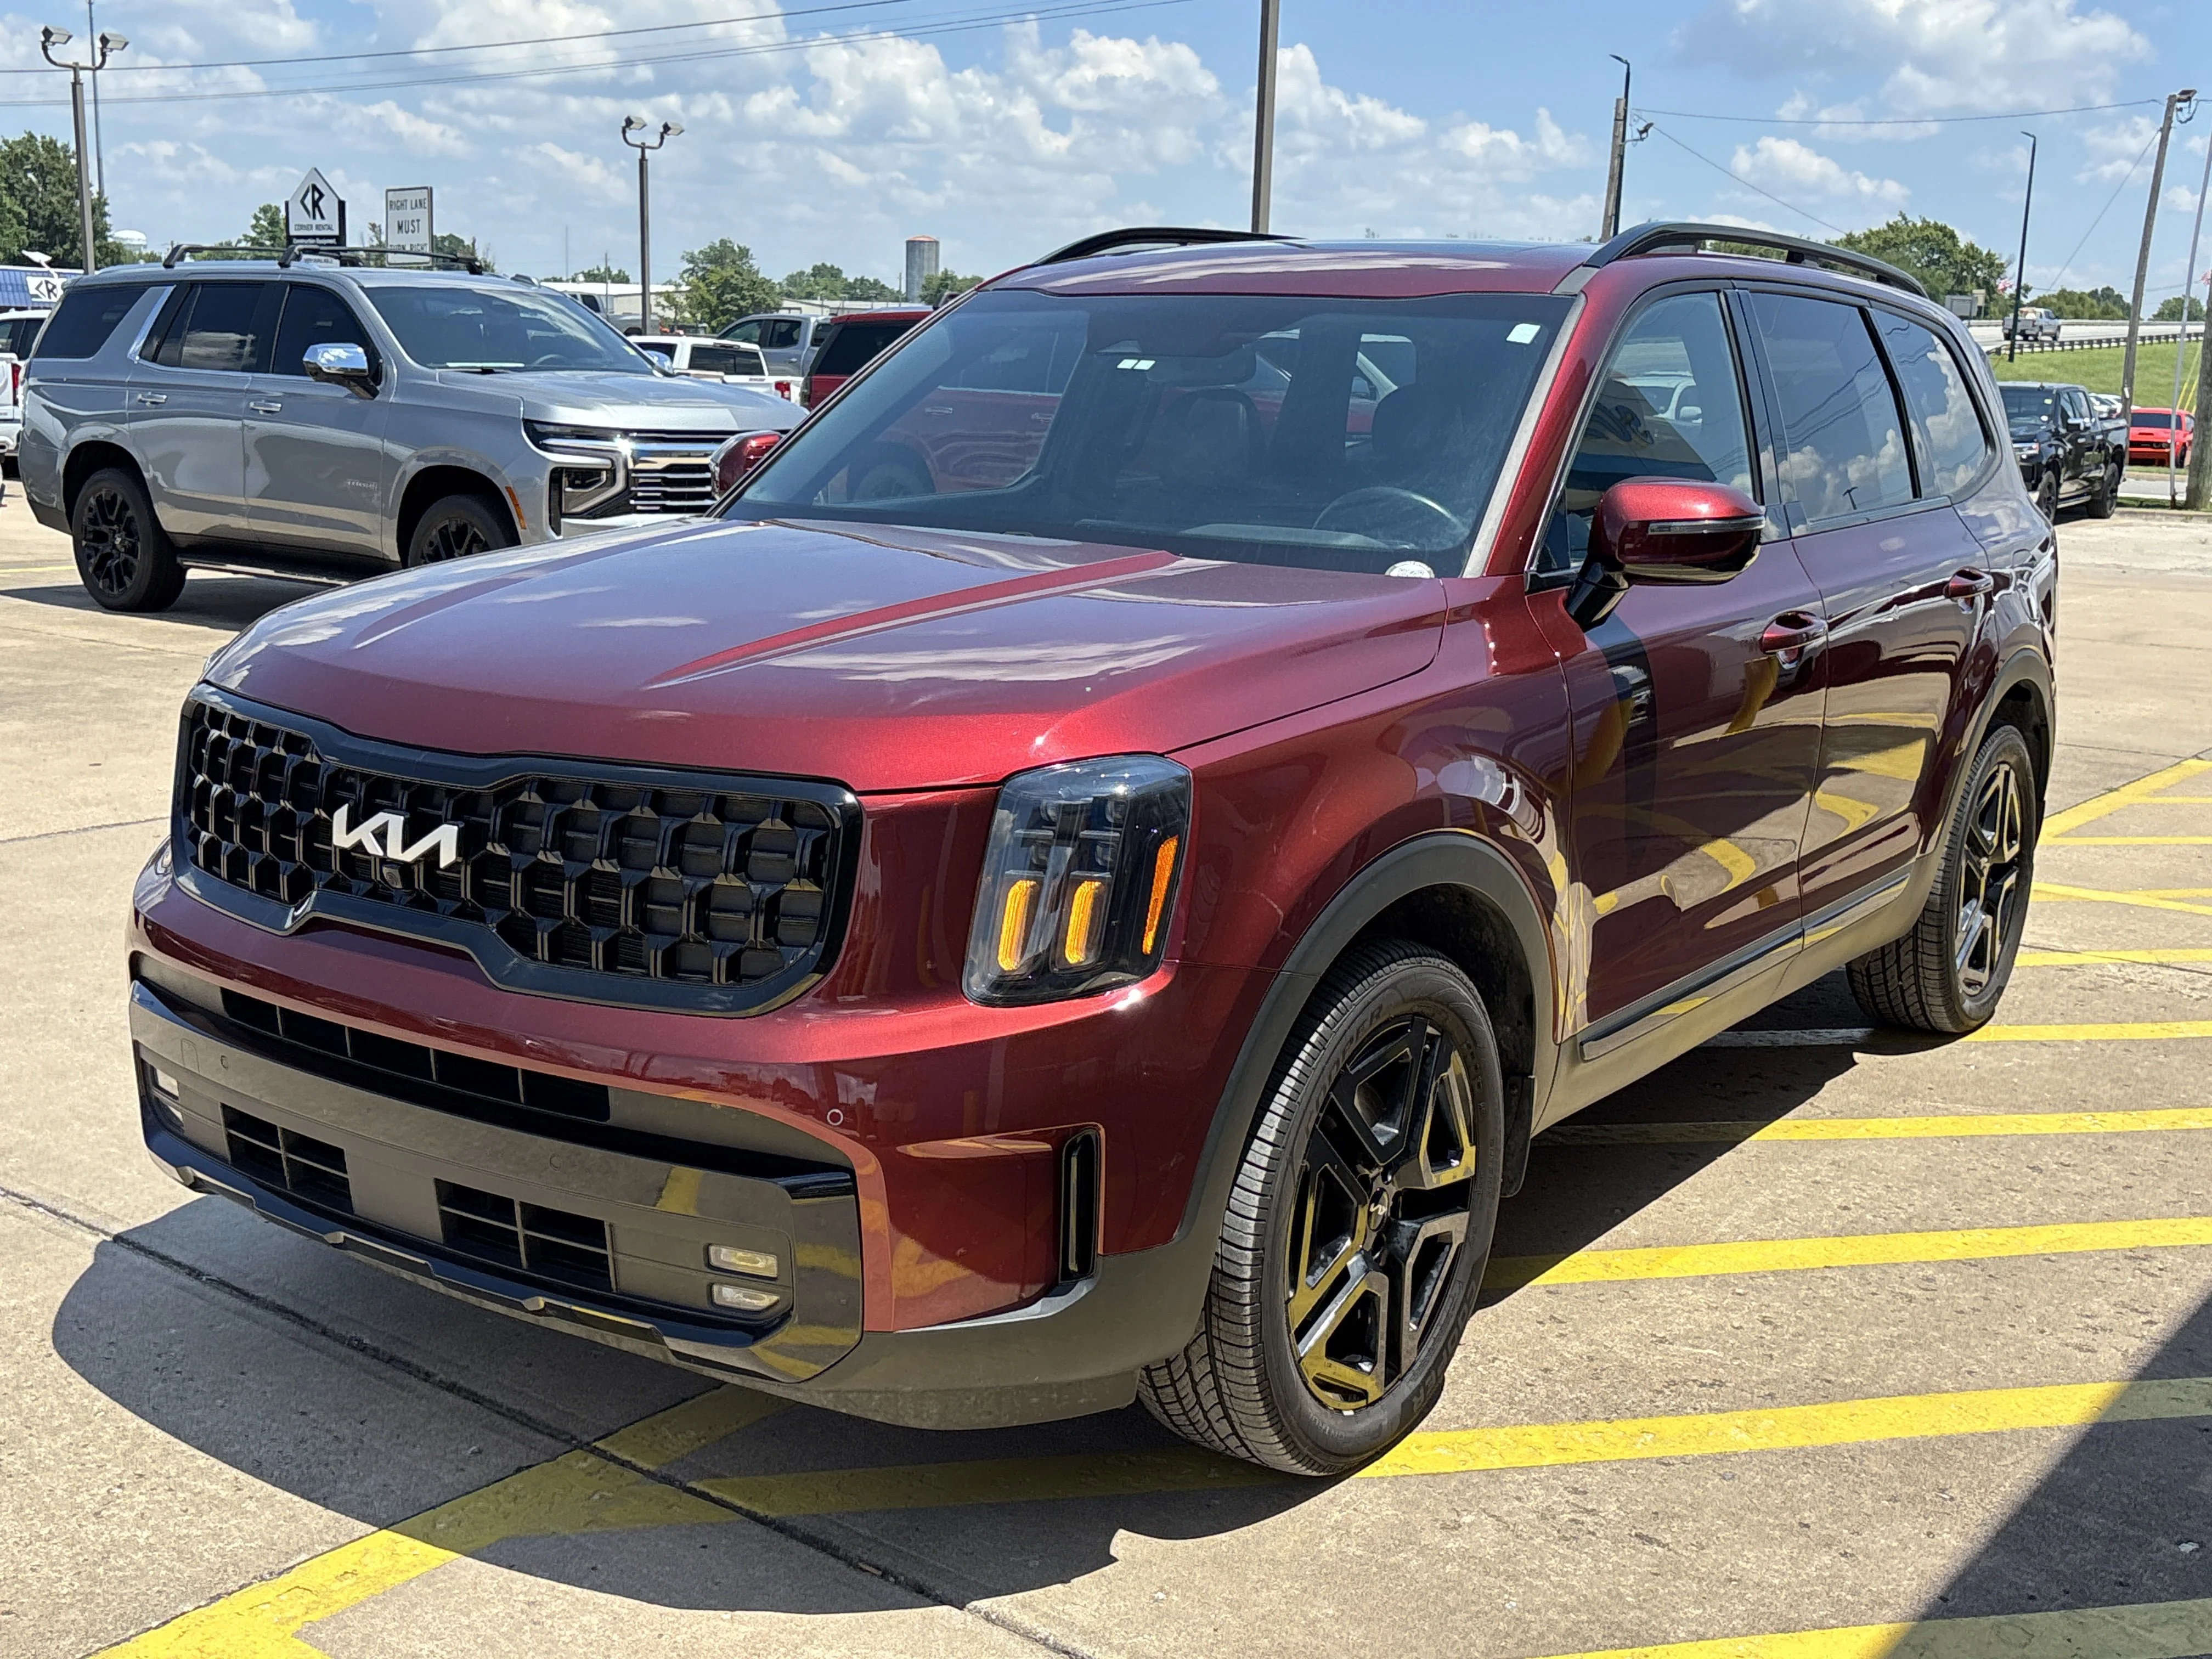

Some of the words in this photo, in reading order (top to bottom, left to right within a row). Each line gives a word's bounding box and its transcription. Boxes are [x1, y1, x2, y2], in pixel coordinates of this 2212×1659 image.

[390, 199, 407, 211] RIGHT
[411, 198, 427, 210] LANE
[397, 219, 420, 234] MUST
